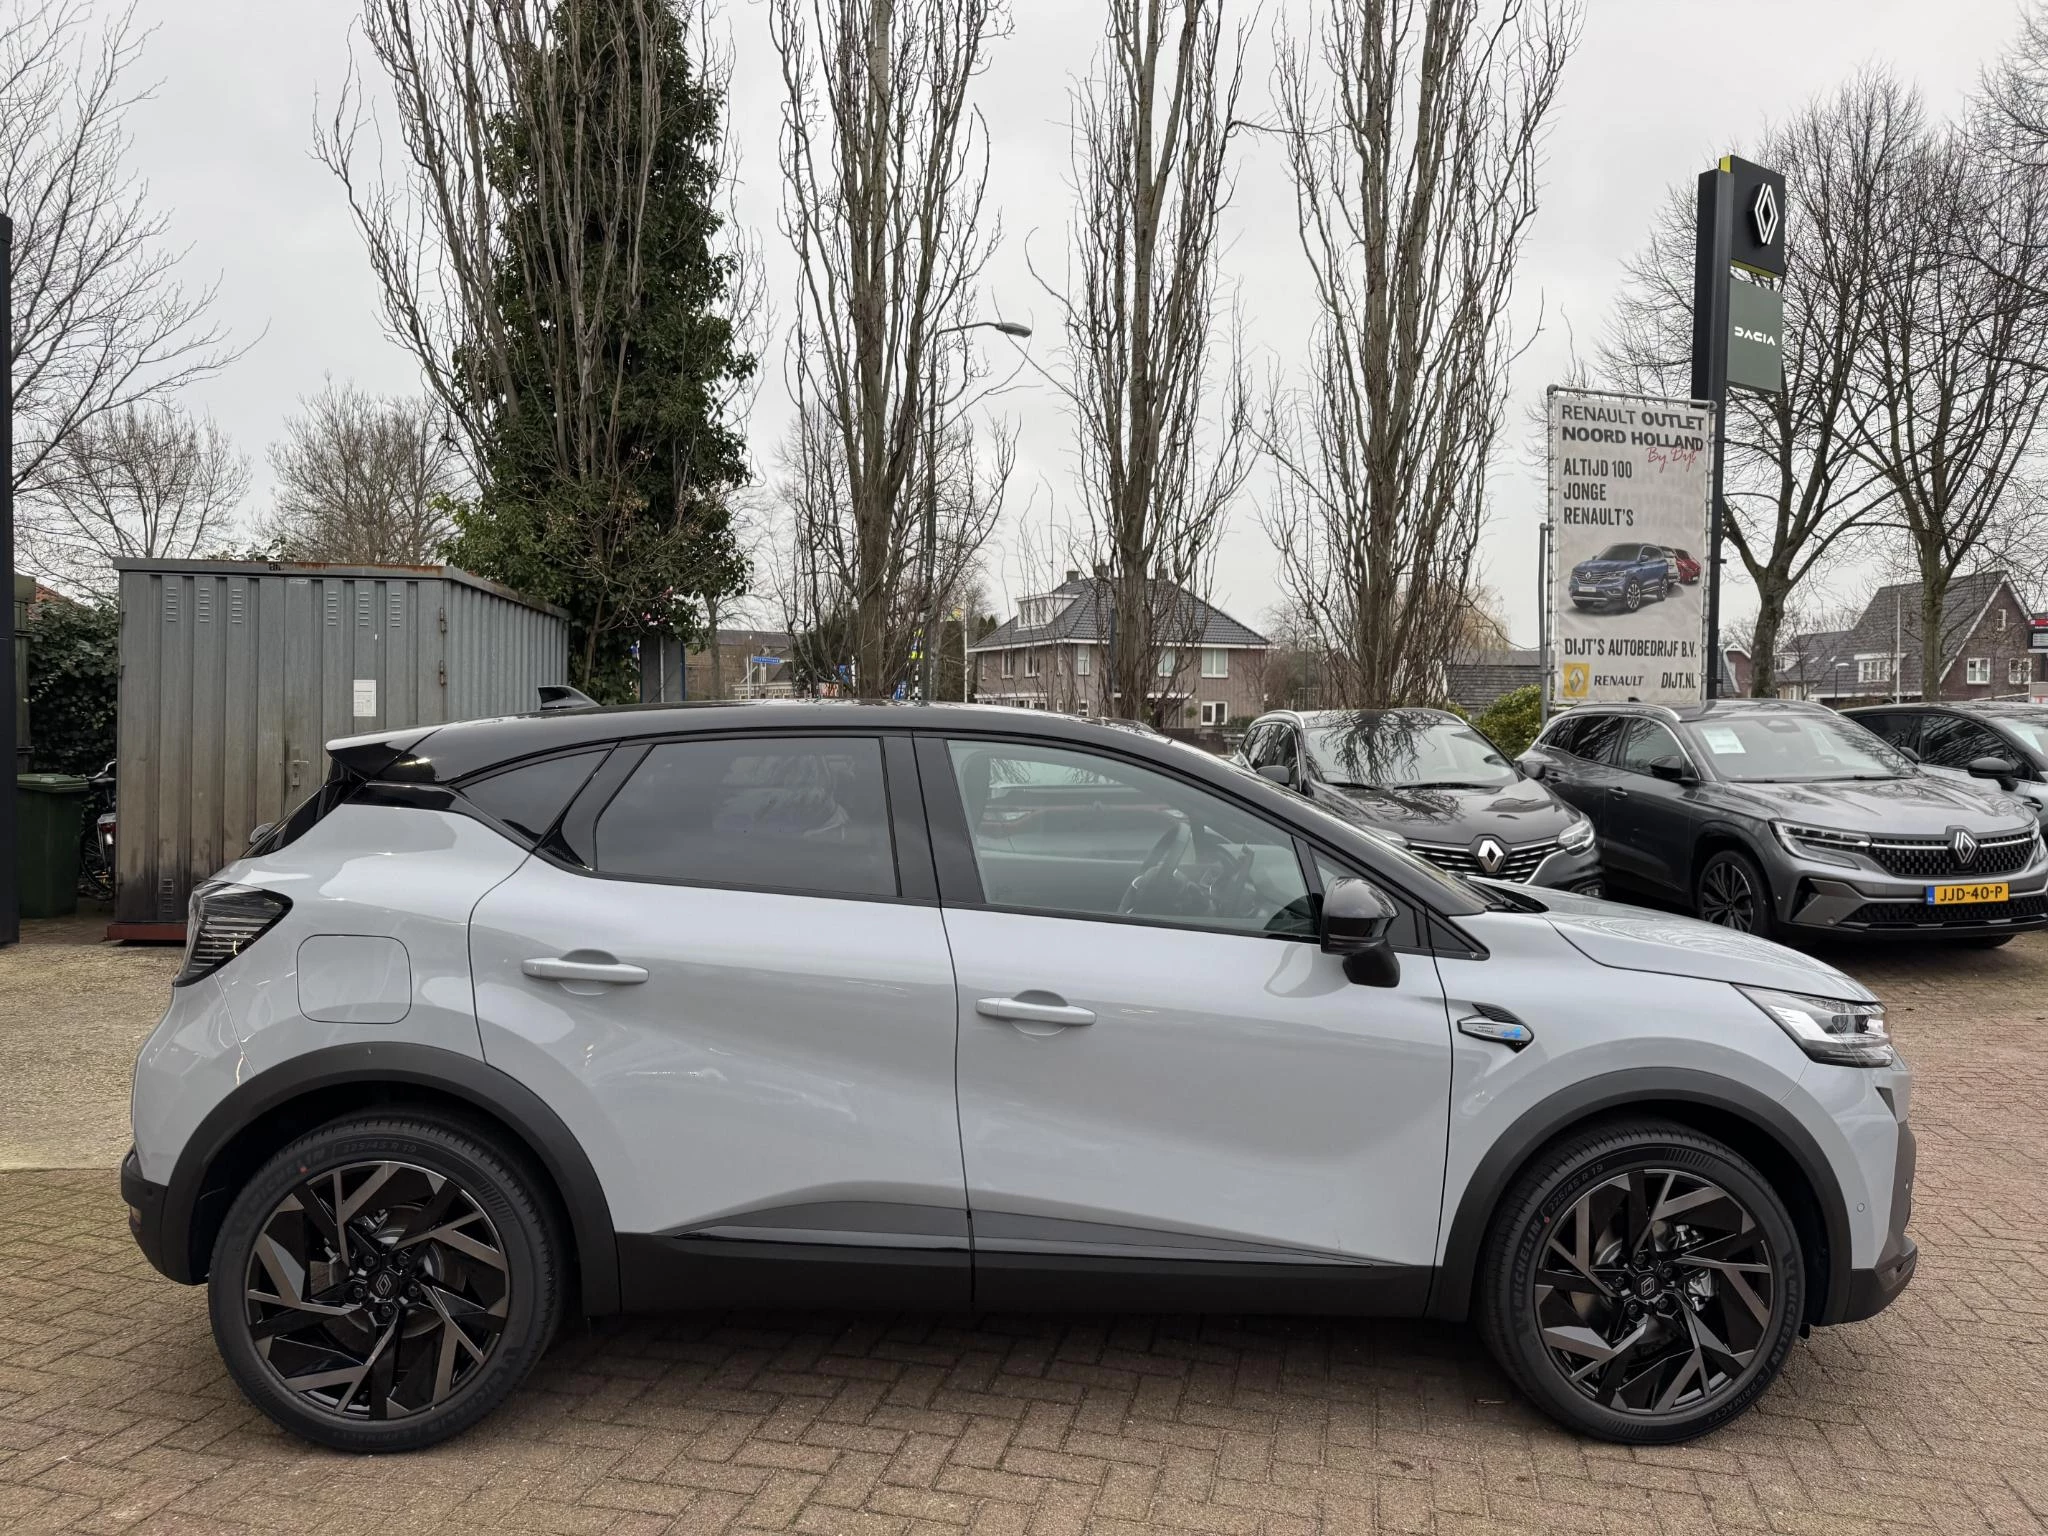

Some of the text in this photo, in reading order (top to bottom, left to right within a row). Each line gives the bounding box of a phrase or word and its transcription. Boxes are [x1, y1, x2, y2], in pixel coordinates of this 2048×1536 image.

[1734, 326, 1775, 346] DACIA
[1562, 405, 1704, 431] RENAULT OUTLET
[1562, 427, 1703, 451] NOORD HOLLAND
[1563, 458, 1632, 478] ALTIJD 100
[1646, 447, 1667, 473] By
[1563, 482, 1606, 501] JONGE
[1563, 507, 1634, 526] RENAULT'S
[1565, 638, 1697, 657] DIJT'S AUTOBEDRIJF B.V.
[1594, 672, 1696, 688] RENAULT DIJT.NL
[1940, 886, 2003, 902] JJD-40-P
[1512, 1220, 1543, 1308] MICHELIN
[1770, 1280, 1799, 1366] MICHELIN
